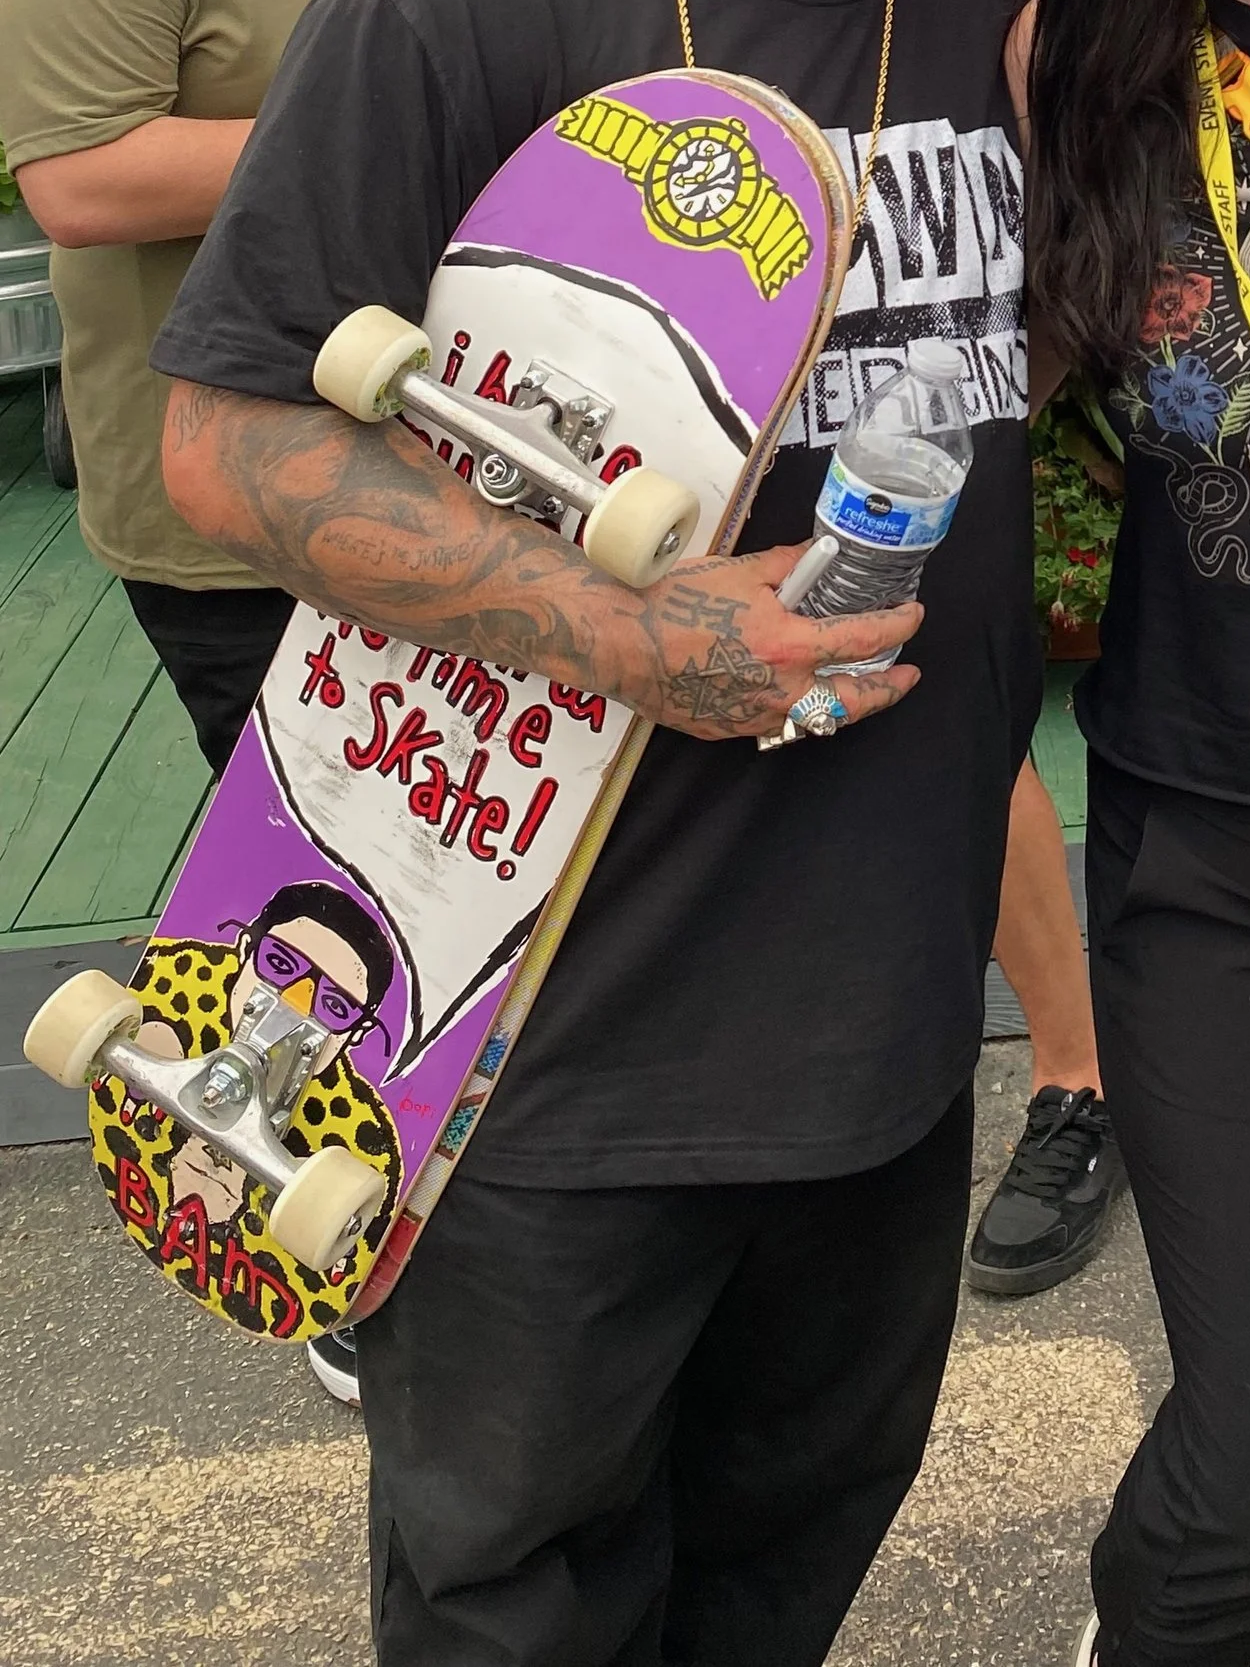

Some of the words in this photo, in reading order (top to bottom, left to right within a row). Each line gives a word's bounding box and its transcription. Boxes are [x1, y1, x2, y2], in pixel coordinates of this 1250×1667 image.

[1213, 179, 1233, 235] STAFF
[845, 506, 900, 533] refreshe
[298, 631, 346, 708] to
[343, 681, 559, 882] Skate!
